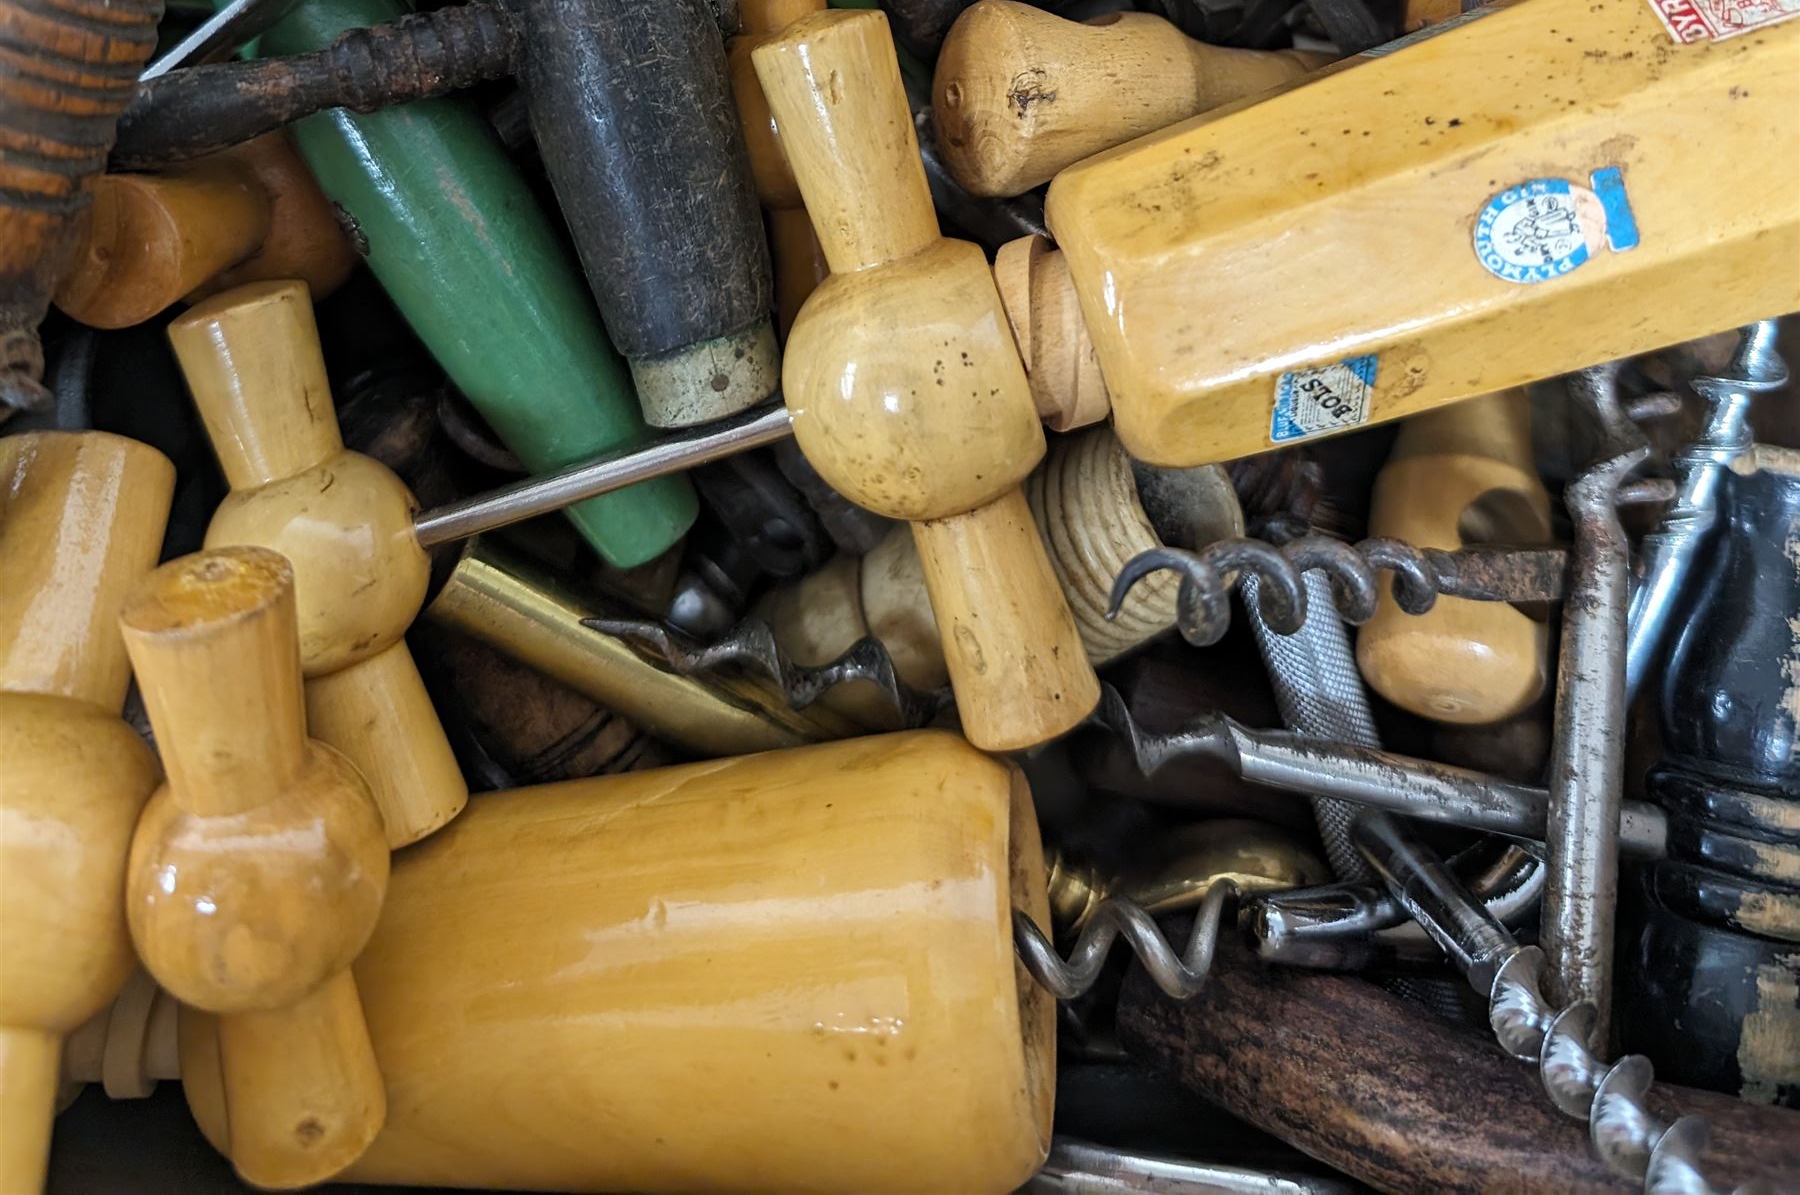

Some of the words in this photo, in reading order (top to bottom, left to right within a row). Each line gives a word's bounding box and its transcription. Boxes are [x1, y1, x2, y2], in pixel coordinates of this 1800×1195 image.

[1501, 182, 1547, 205] GIN
[1476, 207, 1572, 281] PLYMOUTH
[1300, 379, 1352, 418] BOLS
